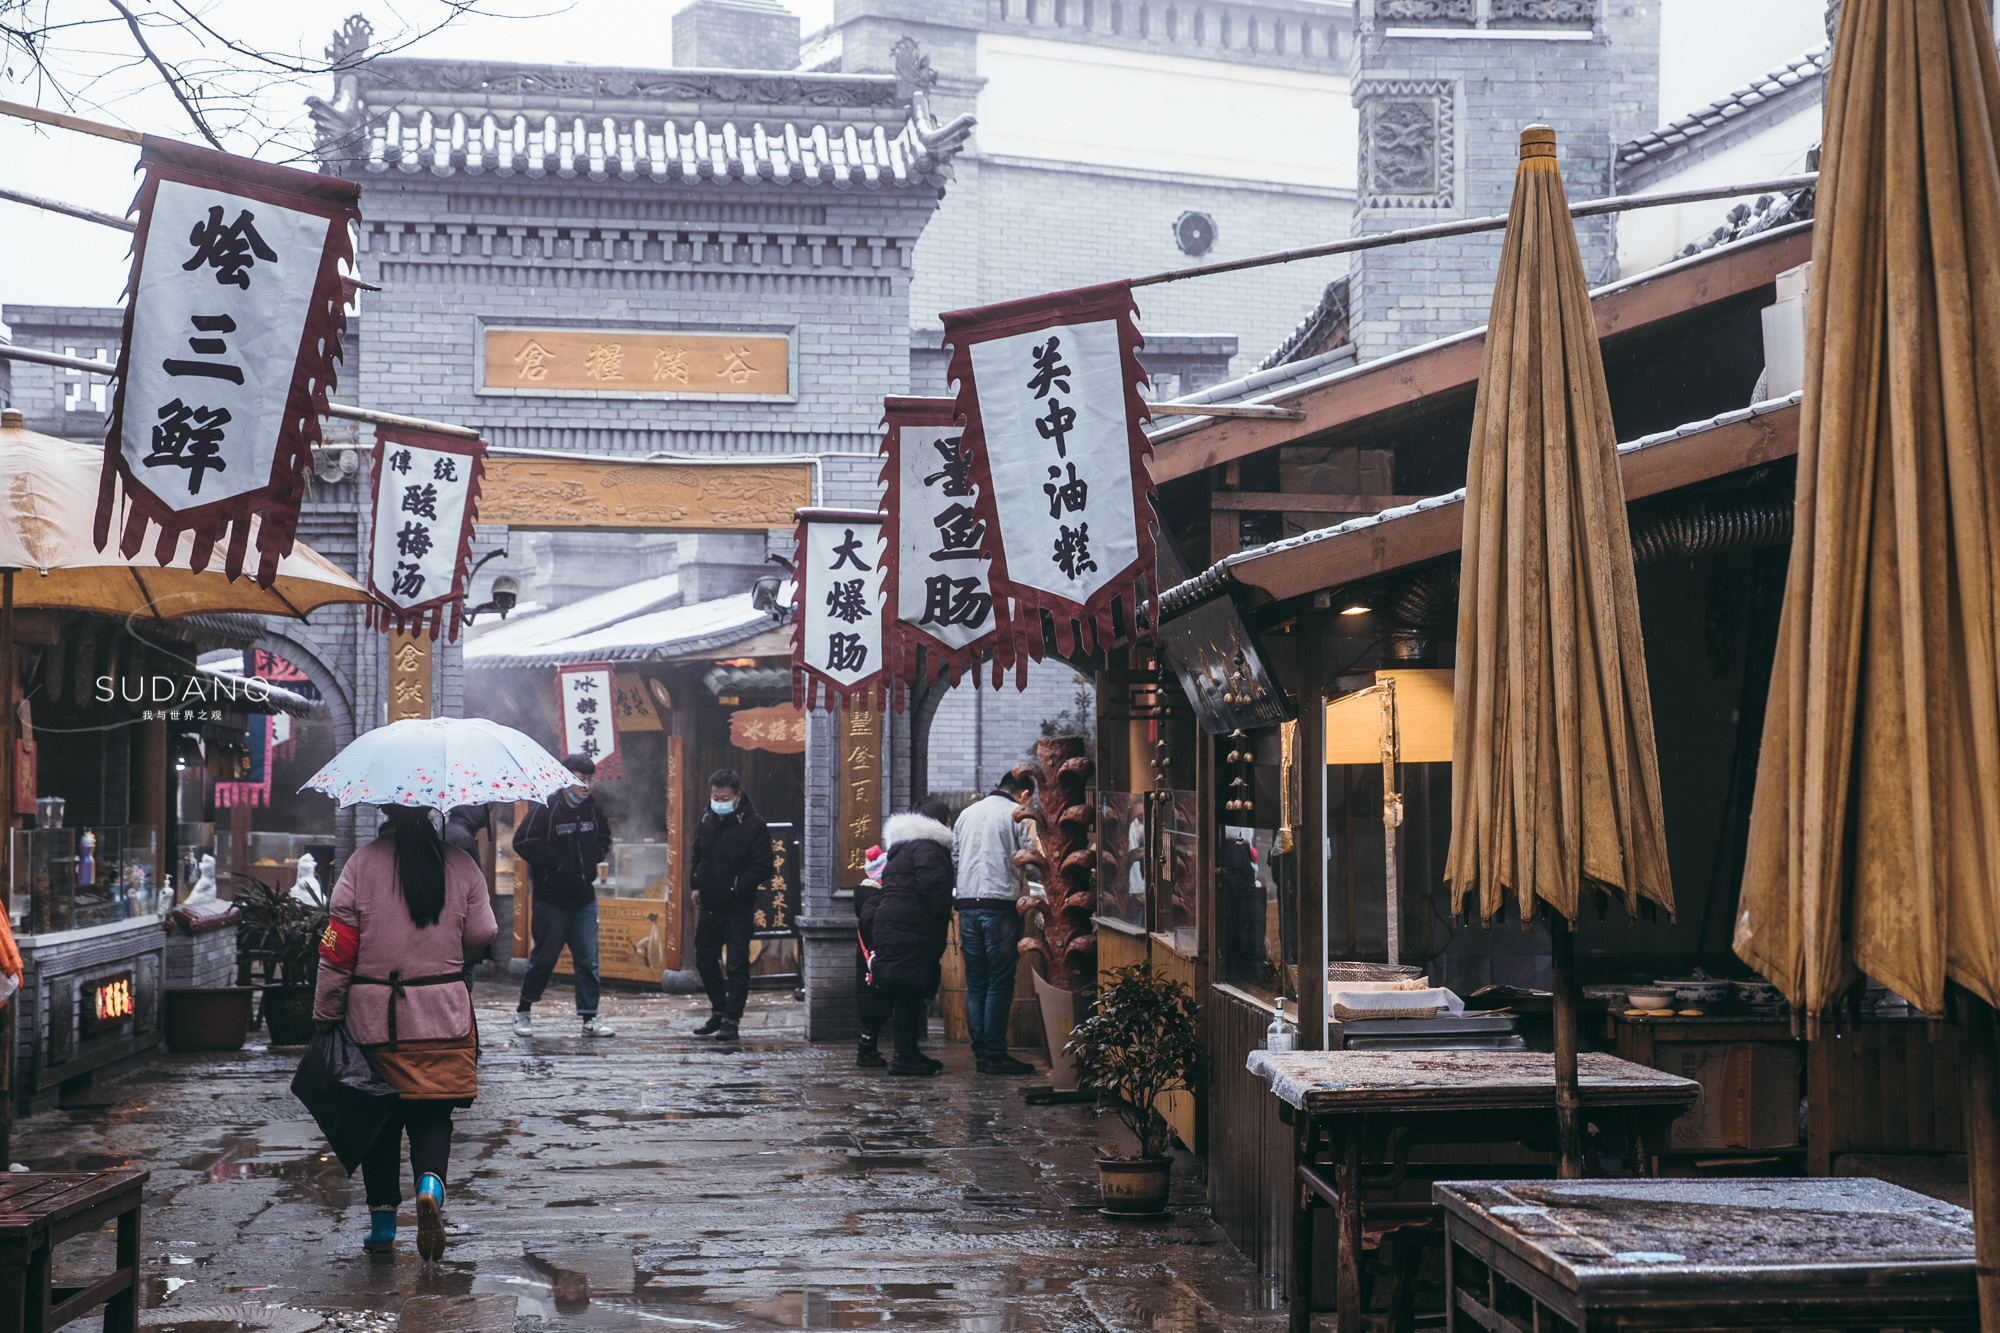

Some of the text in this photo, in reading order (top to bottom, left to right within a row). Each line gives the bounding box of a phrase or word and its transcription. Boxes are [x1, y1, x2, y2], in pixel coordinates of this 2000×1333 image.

[142, 205, 278, 495] 烩三鲜
[1027, 336, 1099, 581] 关中油糕
[391, 482, 438, 600] 酸梅汤
[825, 528, 873, 673] 大爆肠
[917, 436, 993, 630] 墨鱼肠
[573, 675, 601, 759] 冰糖雪梨
[771, 839, 789, 928] 汉中热米皮
